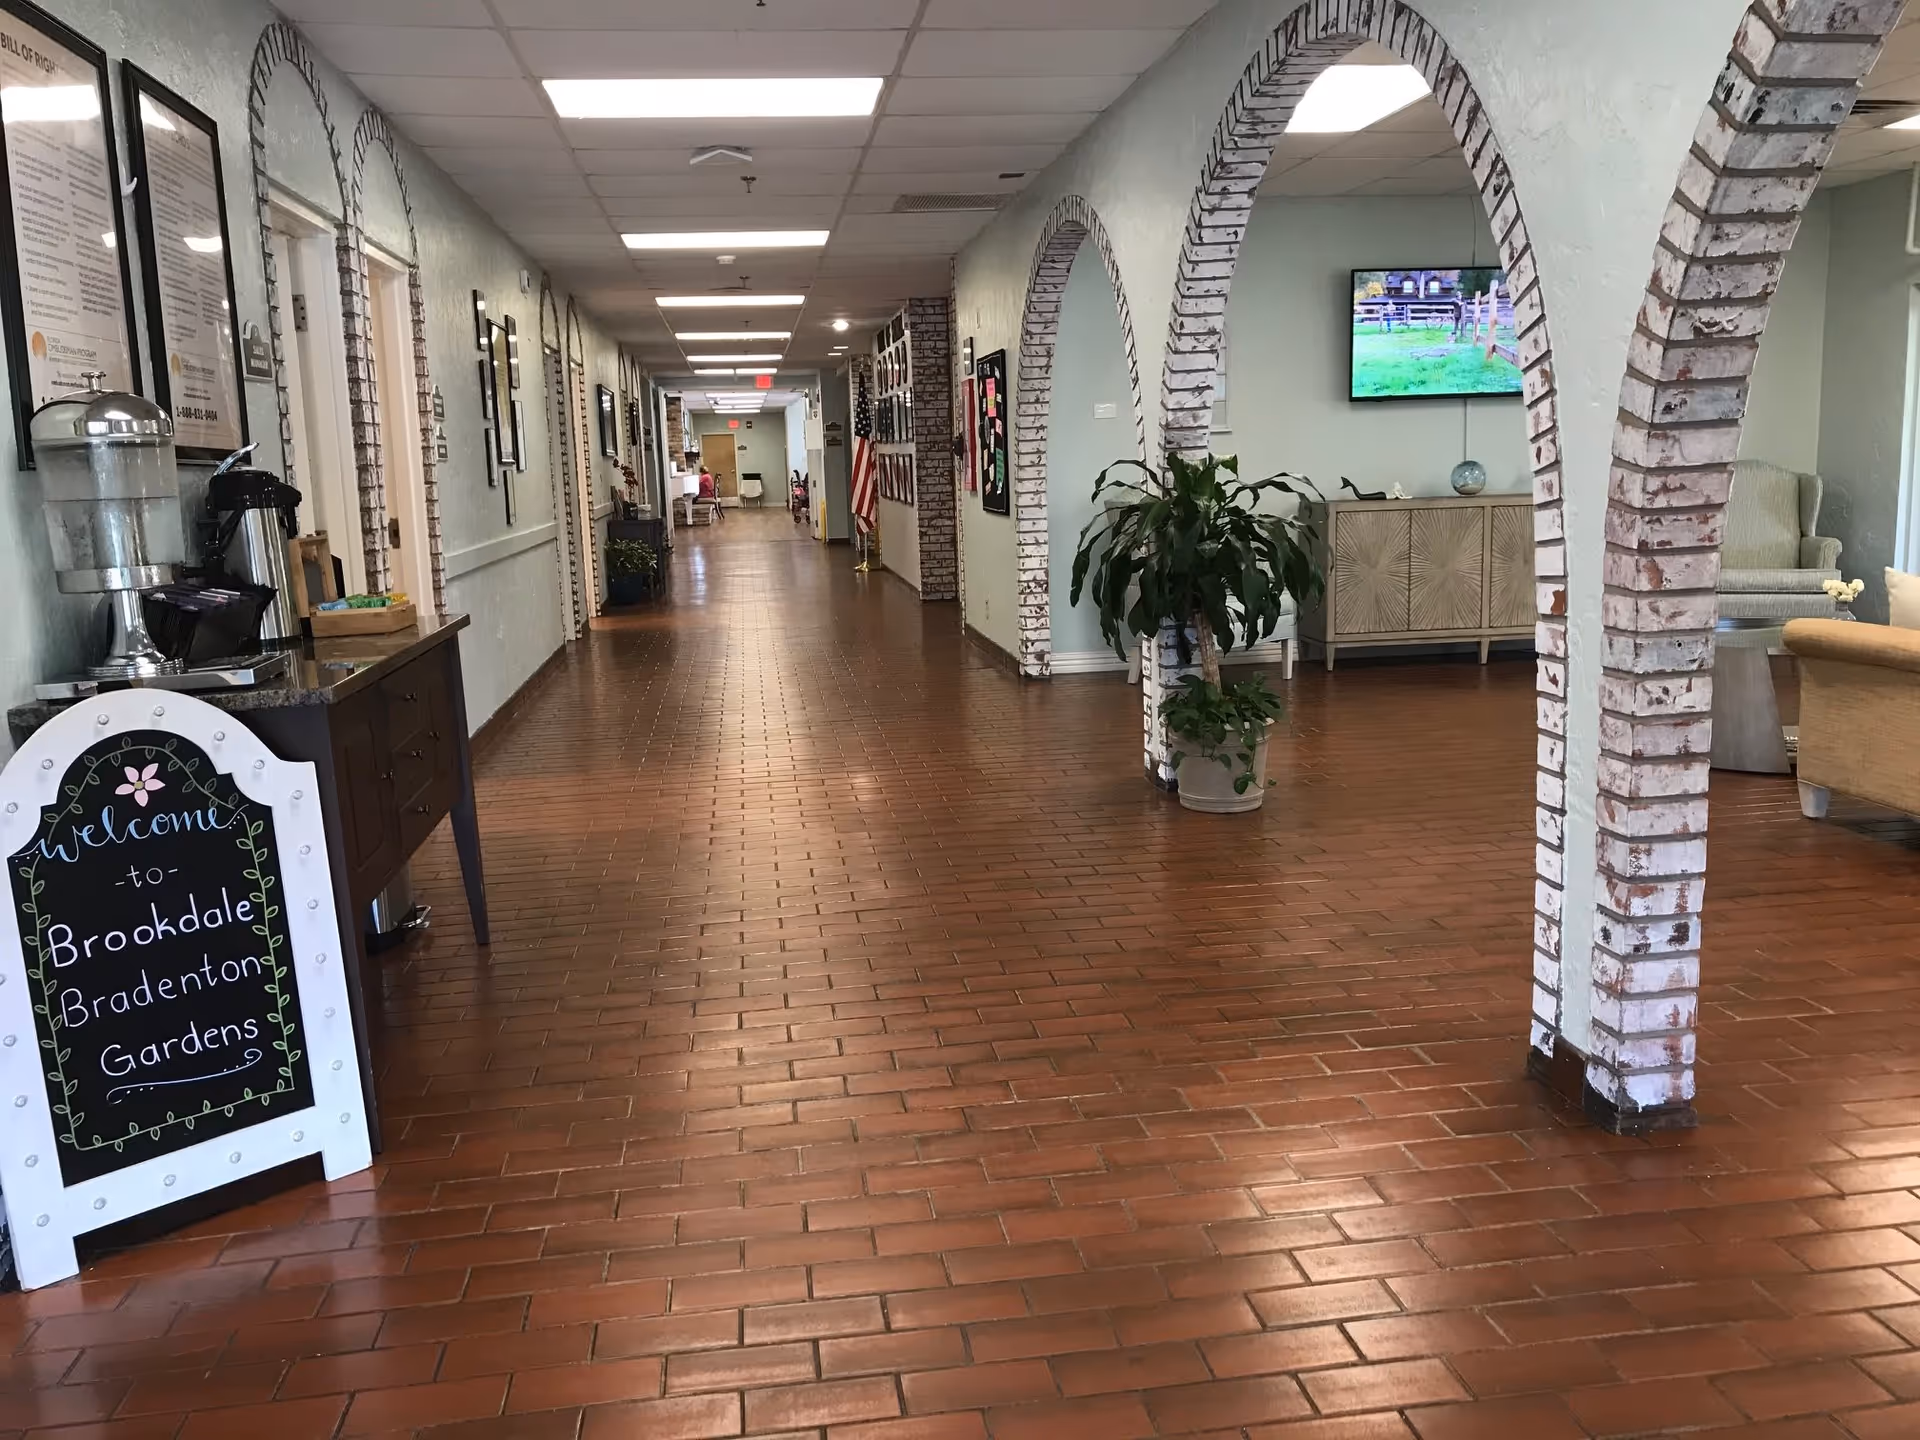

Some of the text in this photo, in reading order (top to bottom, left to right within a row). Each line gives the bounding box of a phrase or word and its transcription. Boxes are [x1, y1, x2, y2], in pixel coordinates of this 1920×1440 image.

[0, 32, 21, 57] BILL
[21, 44, 33, 63] OF
[36, 804, 238, 863] welcome
[47, 886, 255, 968] Brookdale
[60, 952, 262, 1028] Bradenton
[100, 1017, 259, 1076] Gardens
